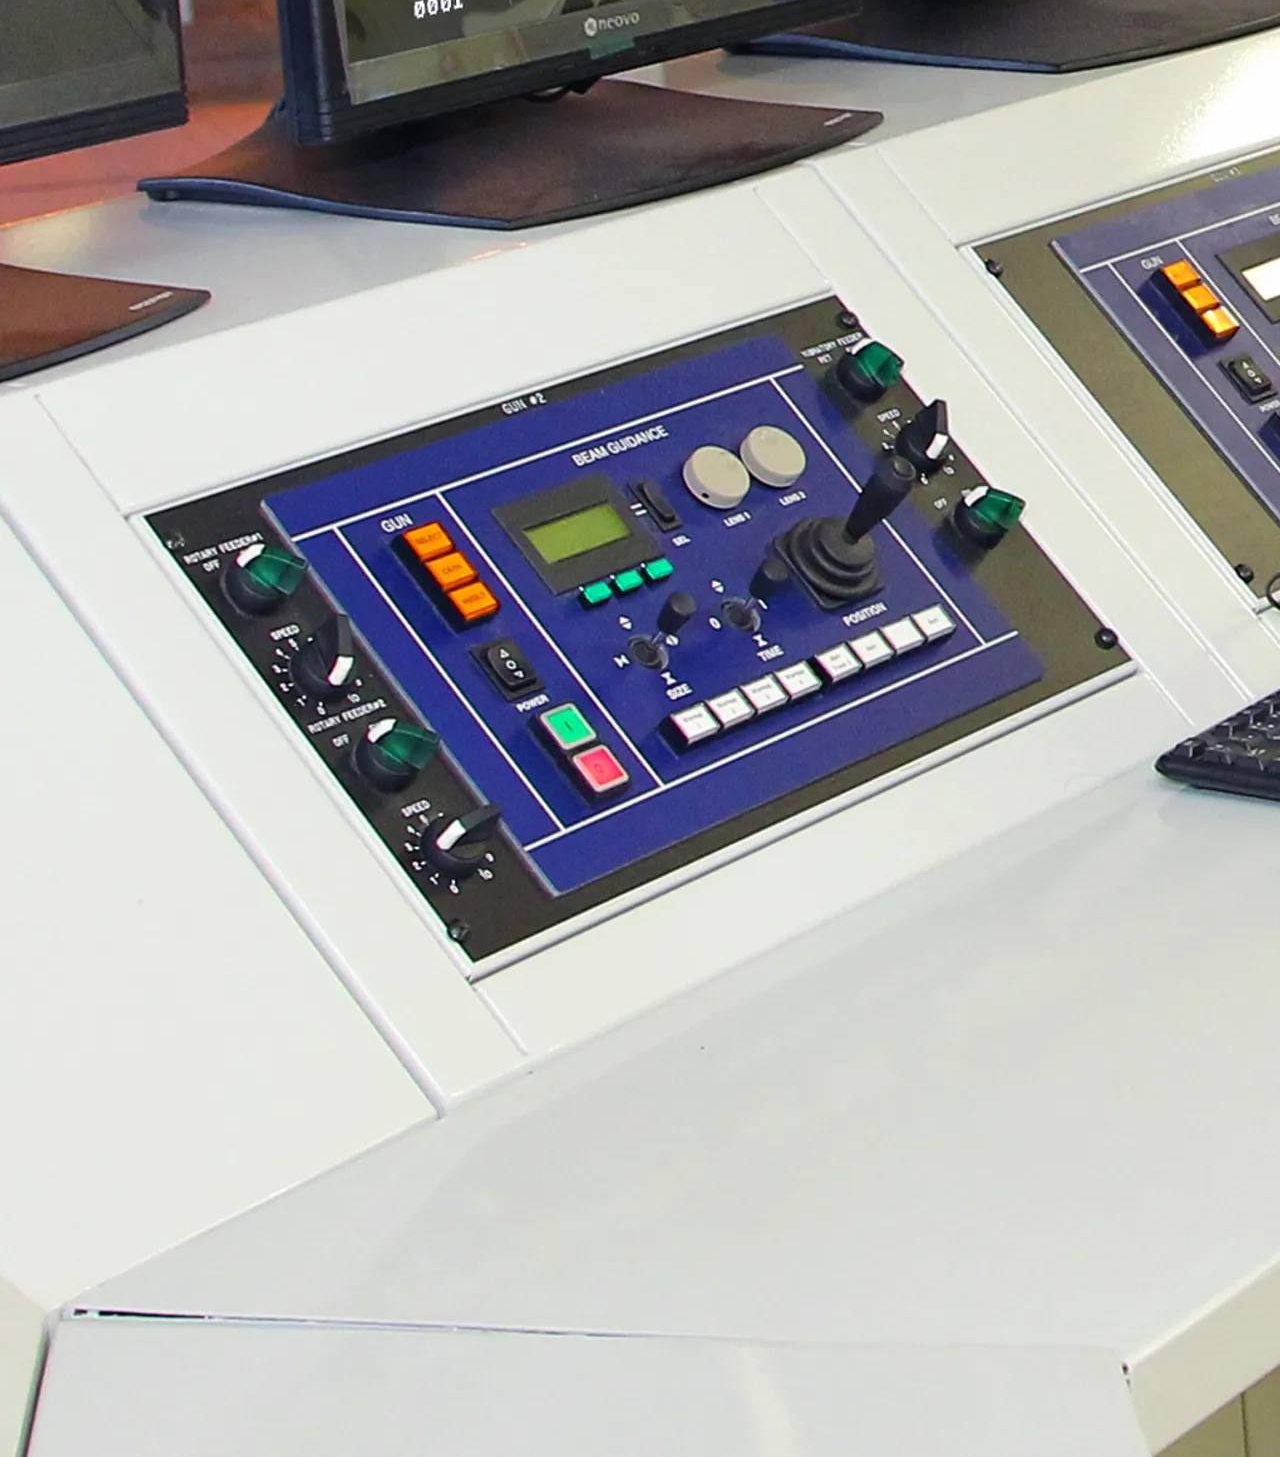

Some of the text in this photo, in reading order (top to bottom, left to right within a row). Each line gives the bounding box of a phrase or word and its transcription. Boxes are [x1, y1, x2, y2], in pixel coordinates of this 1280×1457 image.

[599, 11, 641, 30] neovo
[501, 400, 528, 416] GUN
[571, 424, 670, 468] BEAM GUIDANCE
[380, 513, 413, 533] GUN
[182, 547, 218, 566] ROTARY
[202, 558, 221, 572] OFF
[842, 601, 888, 628] POSITION
[269, 624, 300, 641] SPEED
[756, 645, 785, 663] TIME
[665, 682, 693, 700] SIZE
[516, 693, 550, 713] POWER
[306, 716, 342, 735] ROTARY
[332, 733, 350, 748] OFF
[401, 799, 431, 817] SPEED
